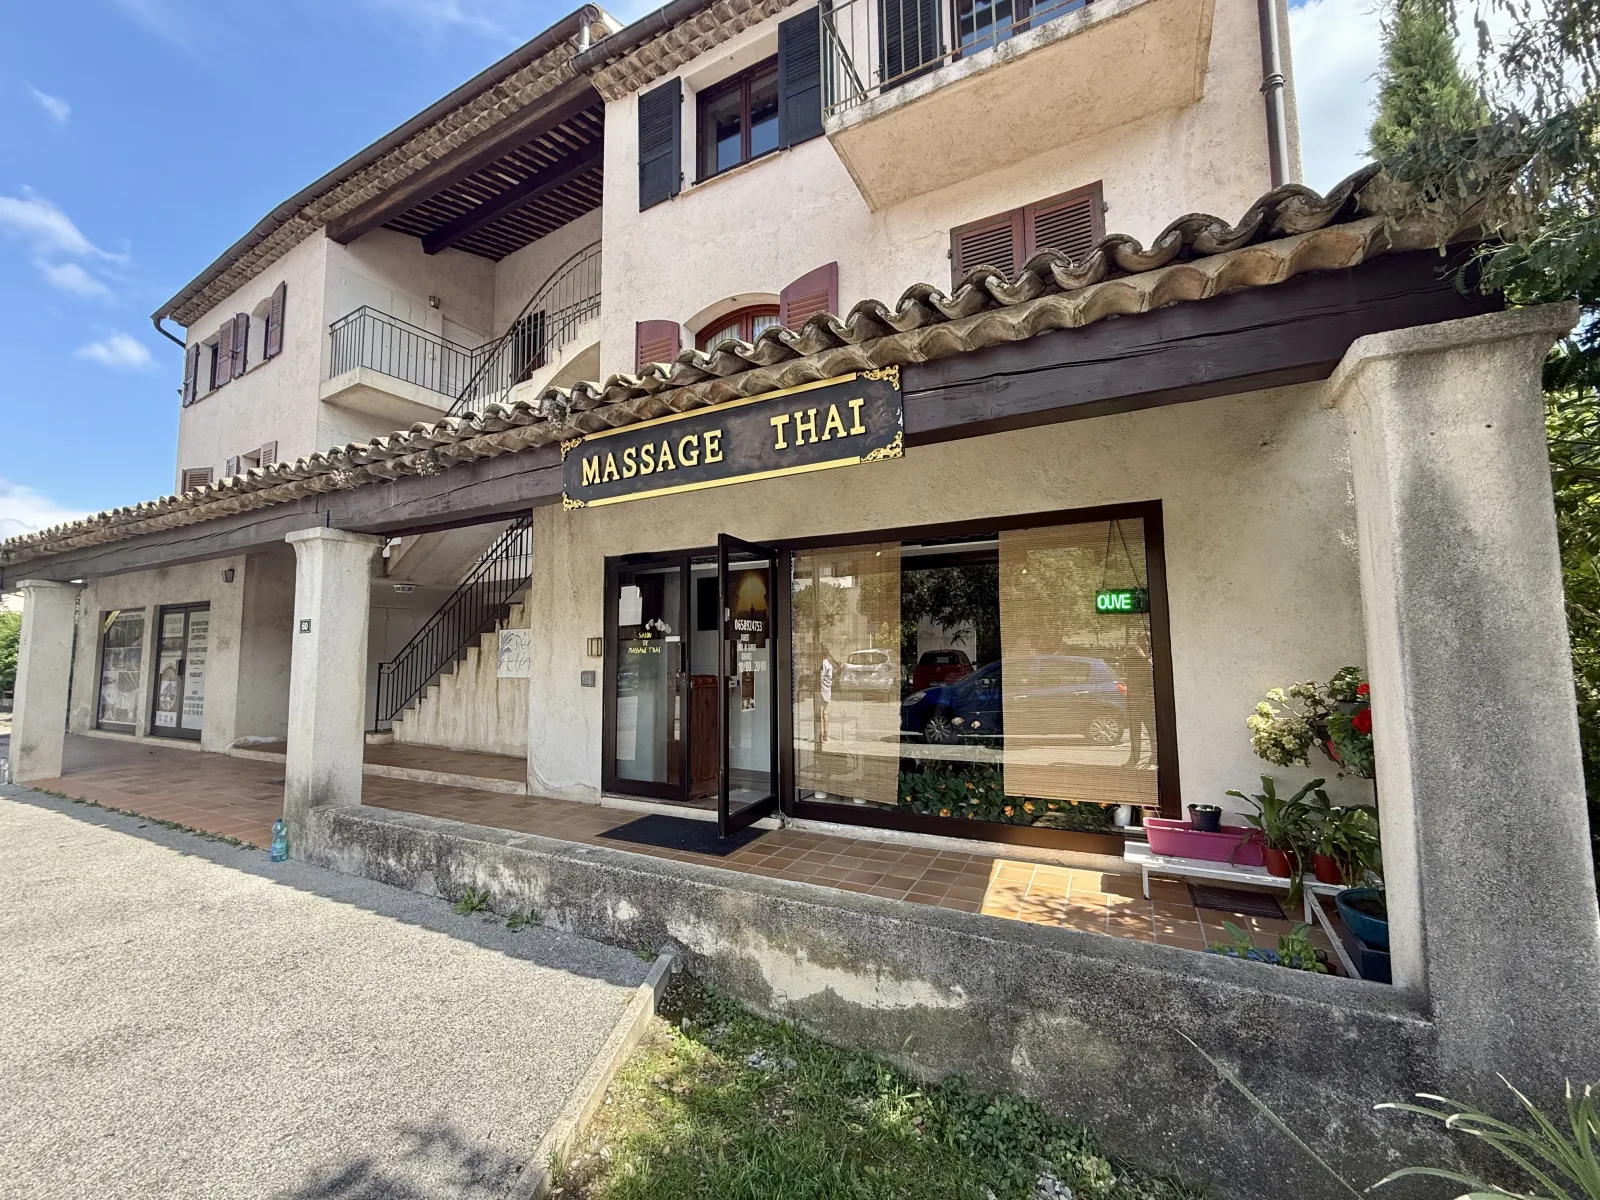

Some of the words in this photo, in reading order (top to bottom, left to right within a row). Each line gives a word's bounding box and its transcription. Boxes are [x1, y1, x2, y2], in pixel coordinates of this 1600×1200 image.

[581, 429, 724, 487] MASSAGE
[770, 398, 867, 450] THAI
[302, 622, 308, 630] 60
